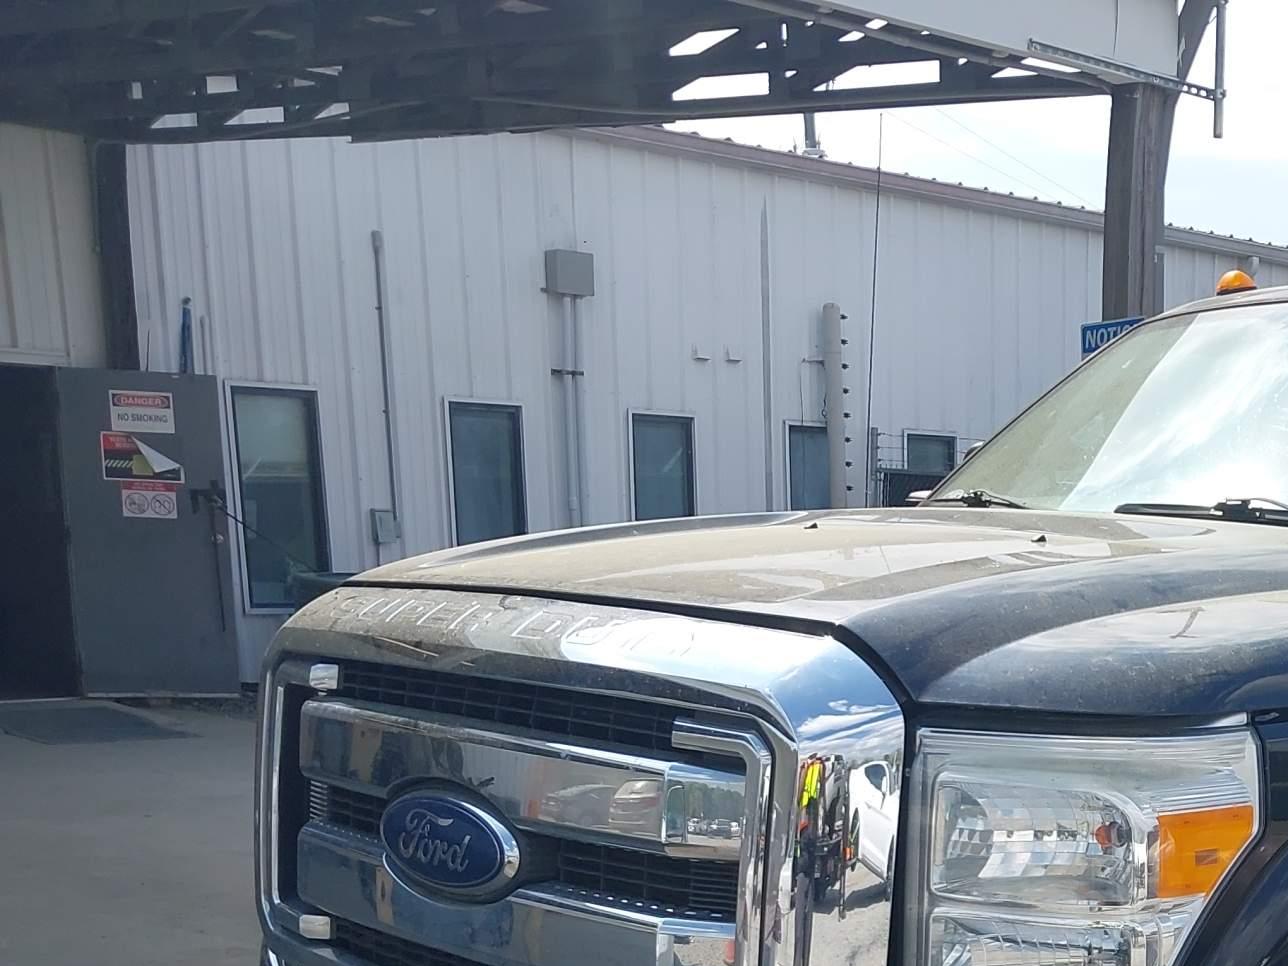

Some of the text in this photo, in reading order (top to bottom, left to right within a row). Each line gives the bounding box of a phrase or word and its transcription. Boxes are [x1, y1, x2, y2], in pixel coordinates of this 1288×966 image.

[1085, 325, 1138, 349] NOT
[120, 396, 162, 406] DANGER
[117, 412, 168, 423] NO SMOKING
[510, 609, 699, 656] DU
[400, 808, 471, 873] Ford
